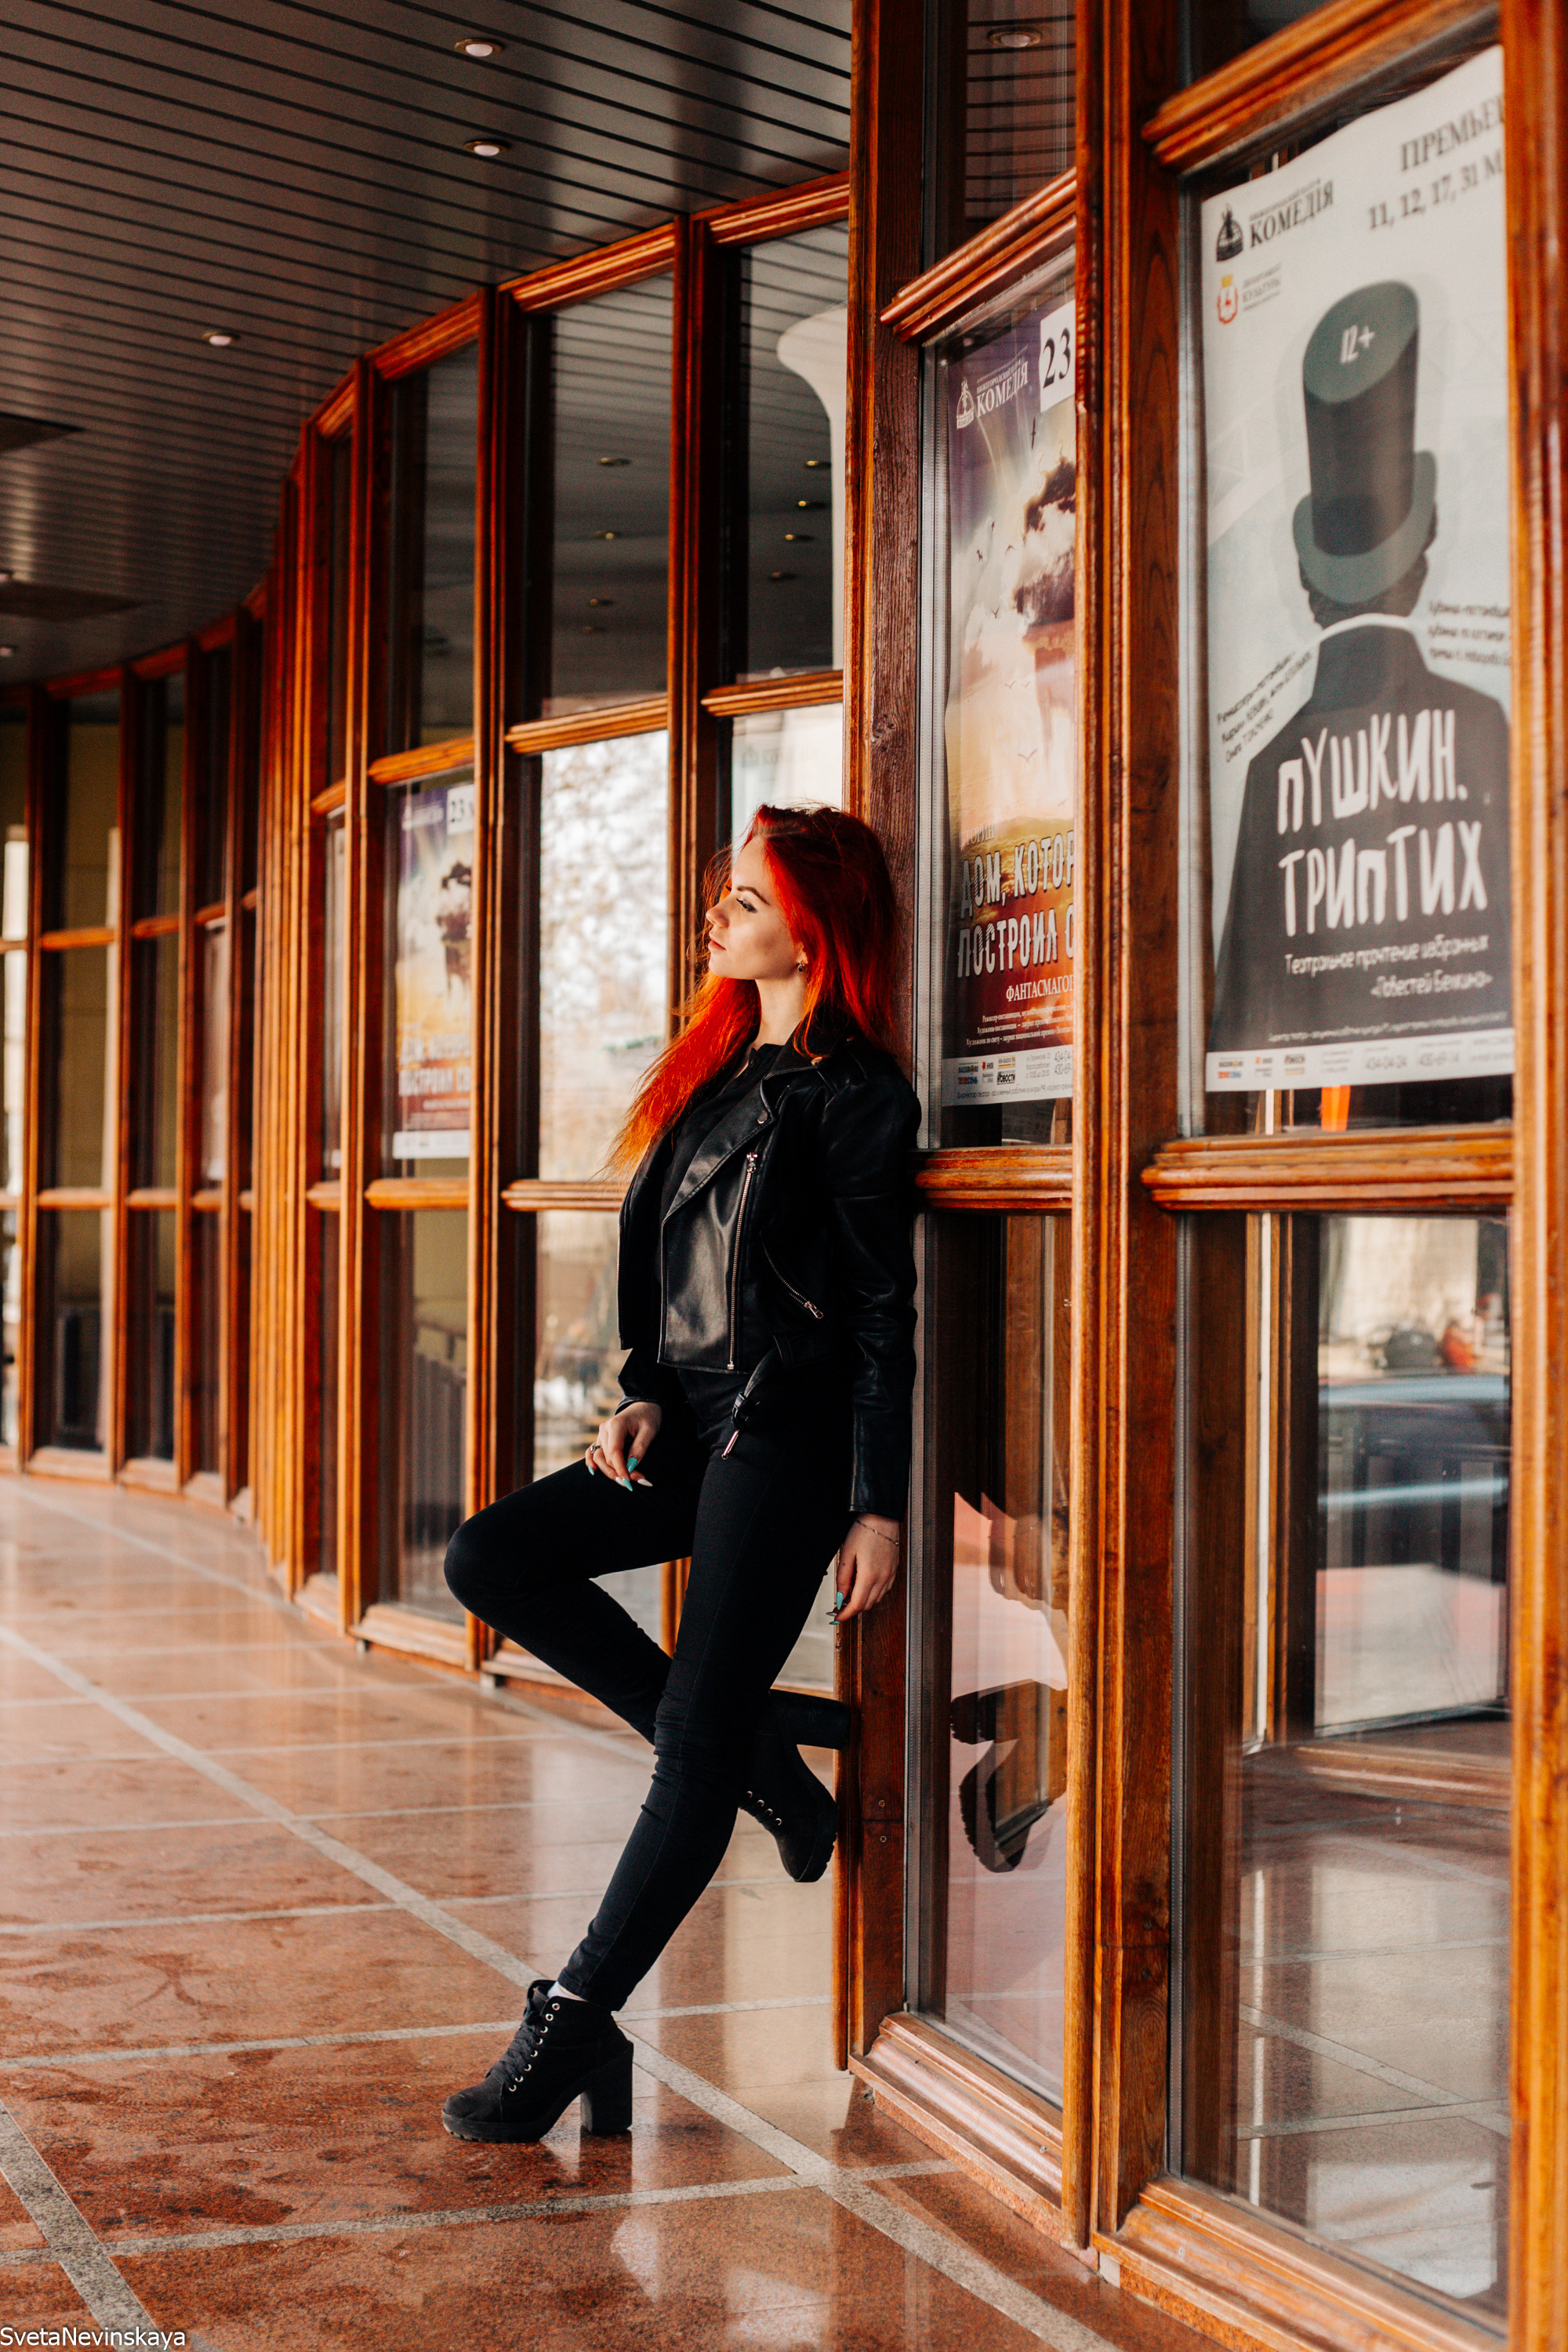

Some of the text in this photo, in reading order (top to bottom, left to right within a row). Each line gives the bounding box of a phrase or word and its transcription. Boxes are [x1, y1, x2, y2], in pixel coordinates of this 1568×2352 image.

[1043, 327, 1071, 390] 23
[1341, 325, 1375, 364] 12+
[967, 823, 995, 847] ГОРИН
[960, 851, 1006, 919] ДОМ,
[1278, 820, 1487, 937] ТРИПТИХ
[957, 908, 1058, 978] ПОСТРОИЛ
